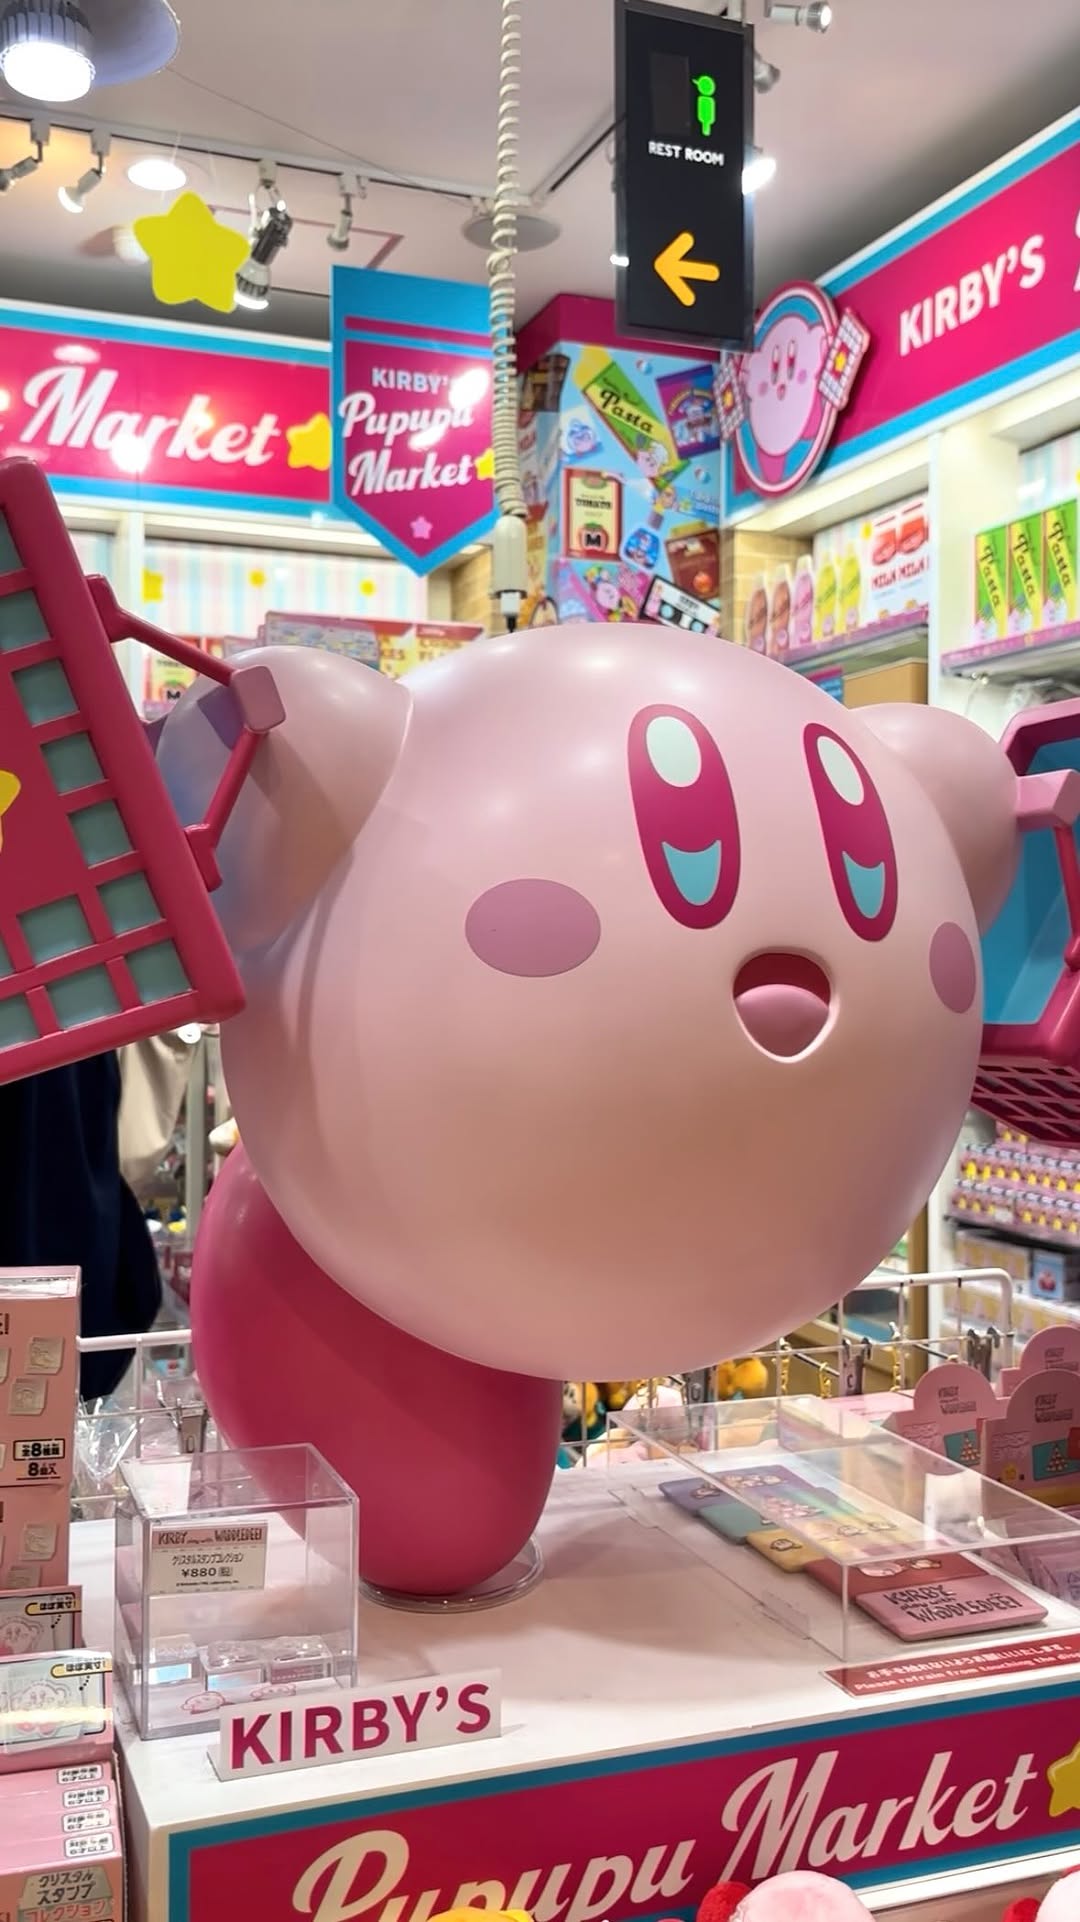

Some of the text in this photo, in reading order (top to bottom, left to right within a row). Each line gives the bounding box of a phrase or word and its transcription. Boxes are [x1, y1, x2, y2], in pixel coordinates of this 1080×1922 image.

[648, 141, 724, 166] REST ROOM
[899, 234, 1045, 356] KIRBY’S
[371, 367, 456, 395] KIRBY’
[20, 365, 281, 467] Market
[600, 389, 653, 433] Pasta
[348, 448, 473, 496] Market
[884, 1584, 951, 1605] KIRBY
[230, 1683, 492, 1771] KIRBY’S
[719, 1749, 1038, 1882] Market
[37, 1882, 96, 1905] スタンプ
[39, 1869, 94, 1888] クリスタル
